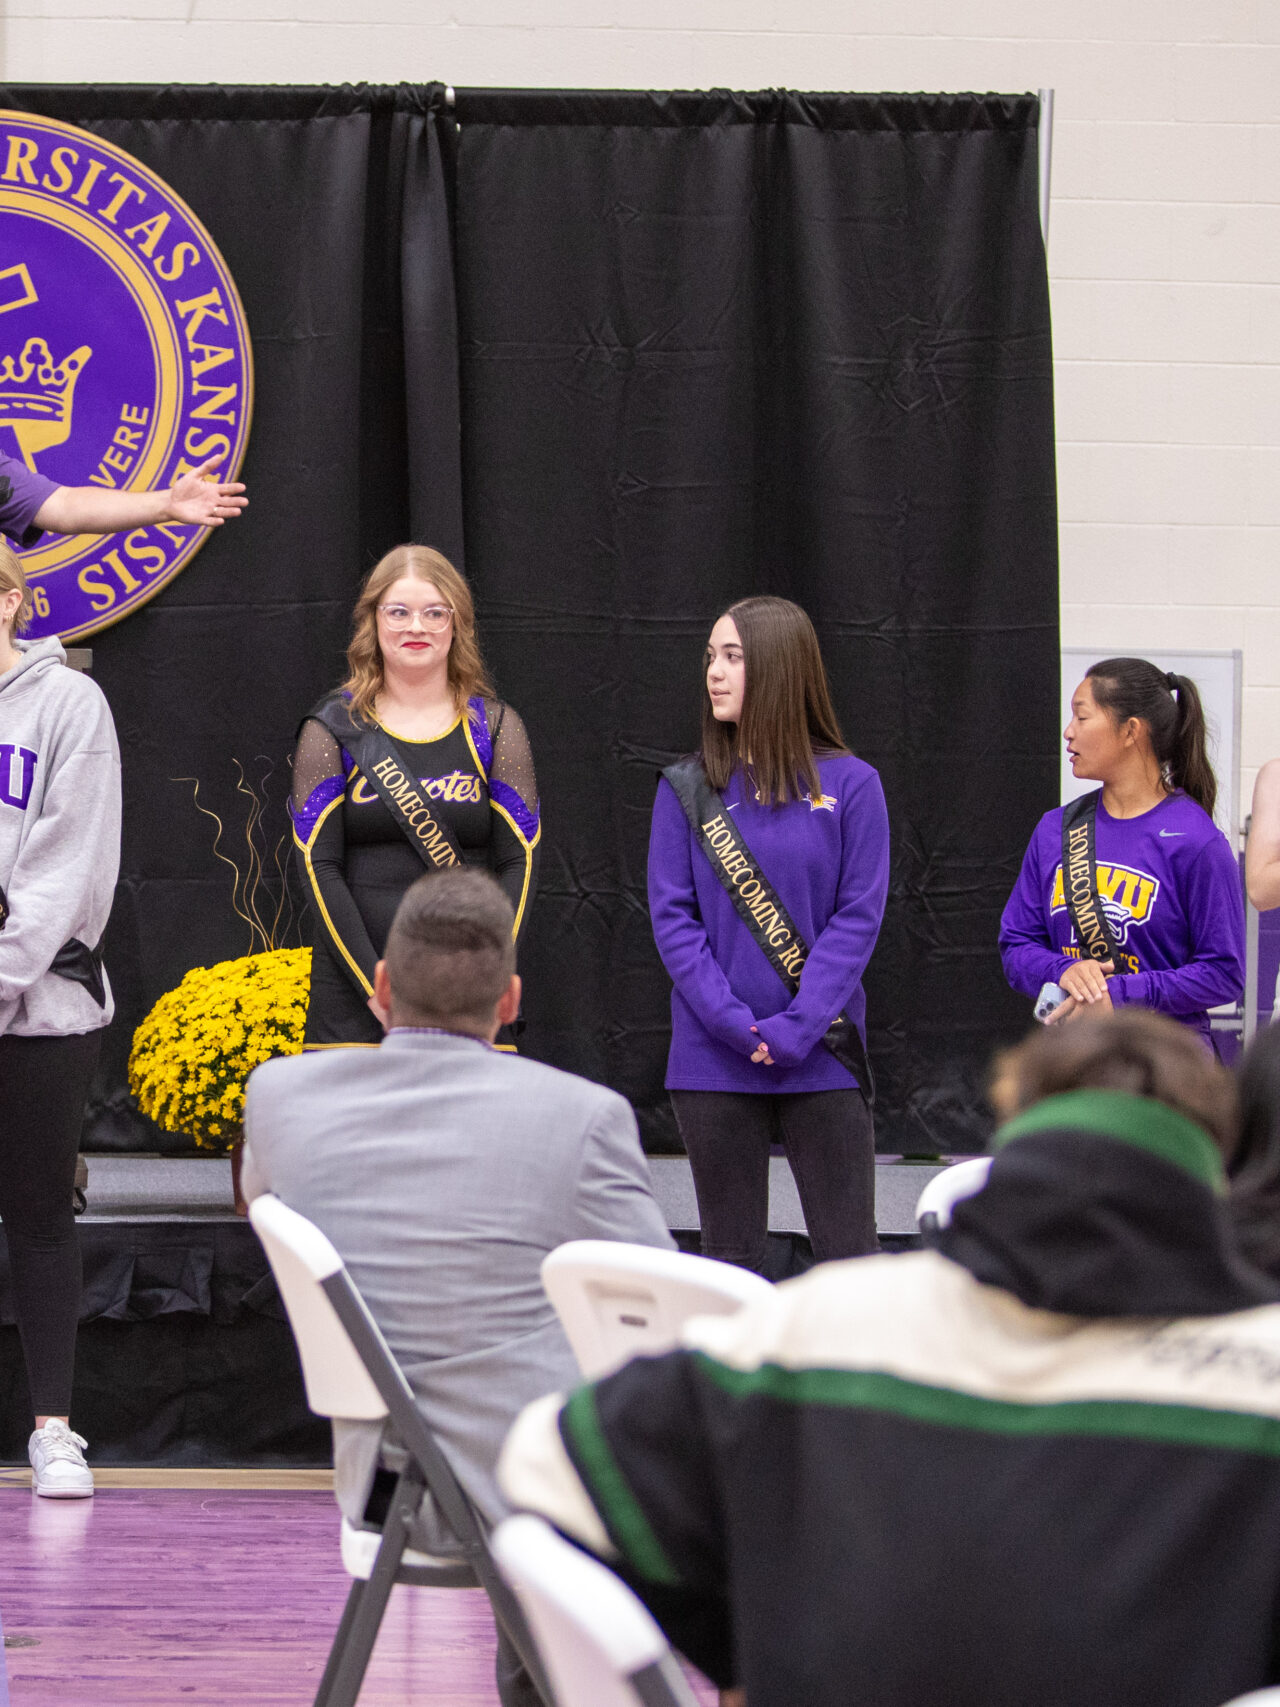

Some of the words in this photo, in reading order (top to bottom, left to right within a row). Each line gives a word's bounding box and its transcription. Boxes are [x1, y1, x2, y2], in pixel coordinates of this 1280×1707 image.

[351, 771, 480, 804] Cotes
[702, 814, 792, 948] HOMECOMING
[1068, 823, 1109, 958] HOMECOMING
